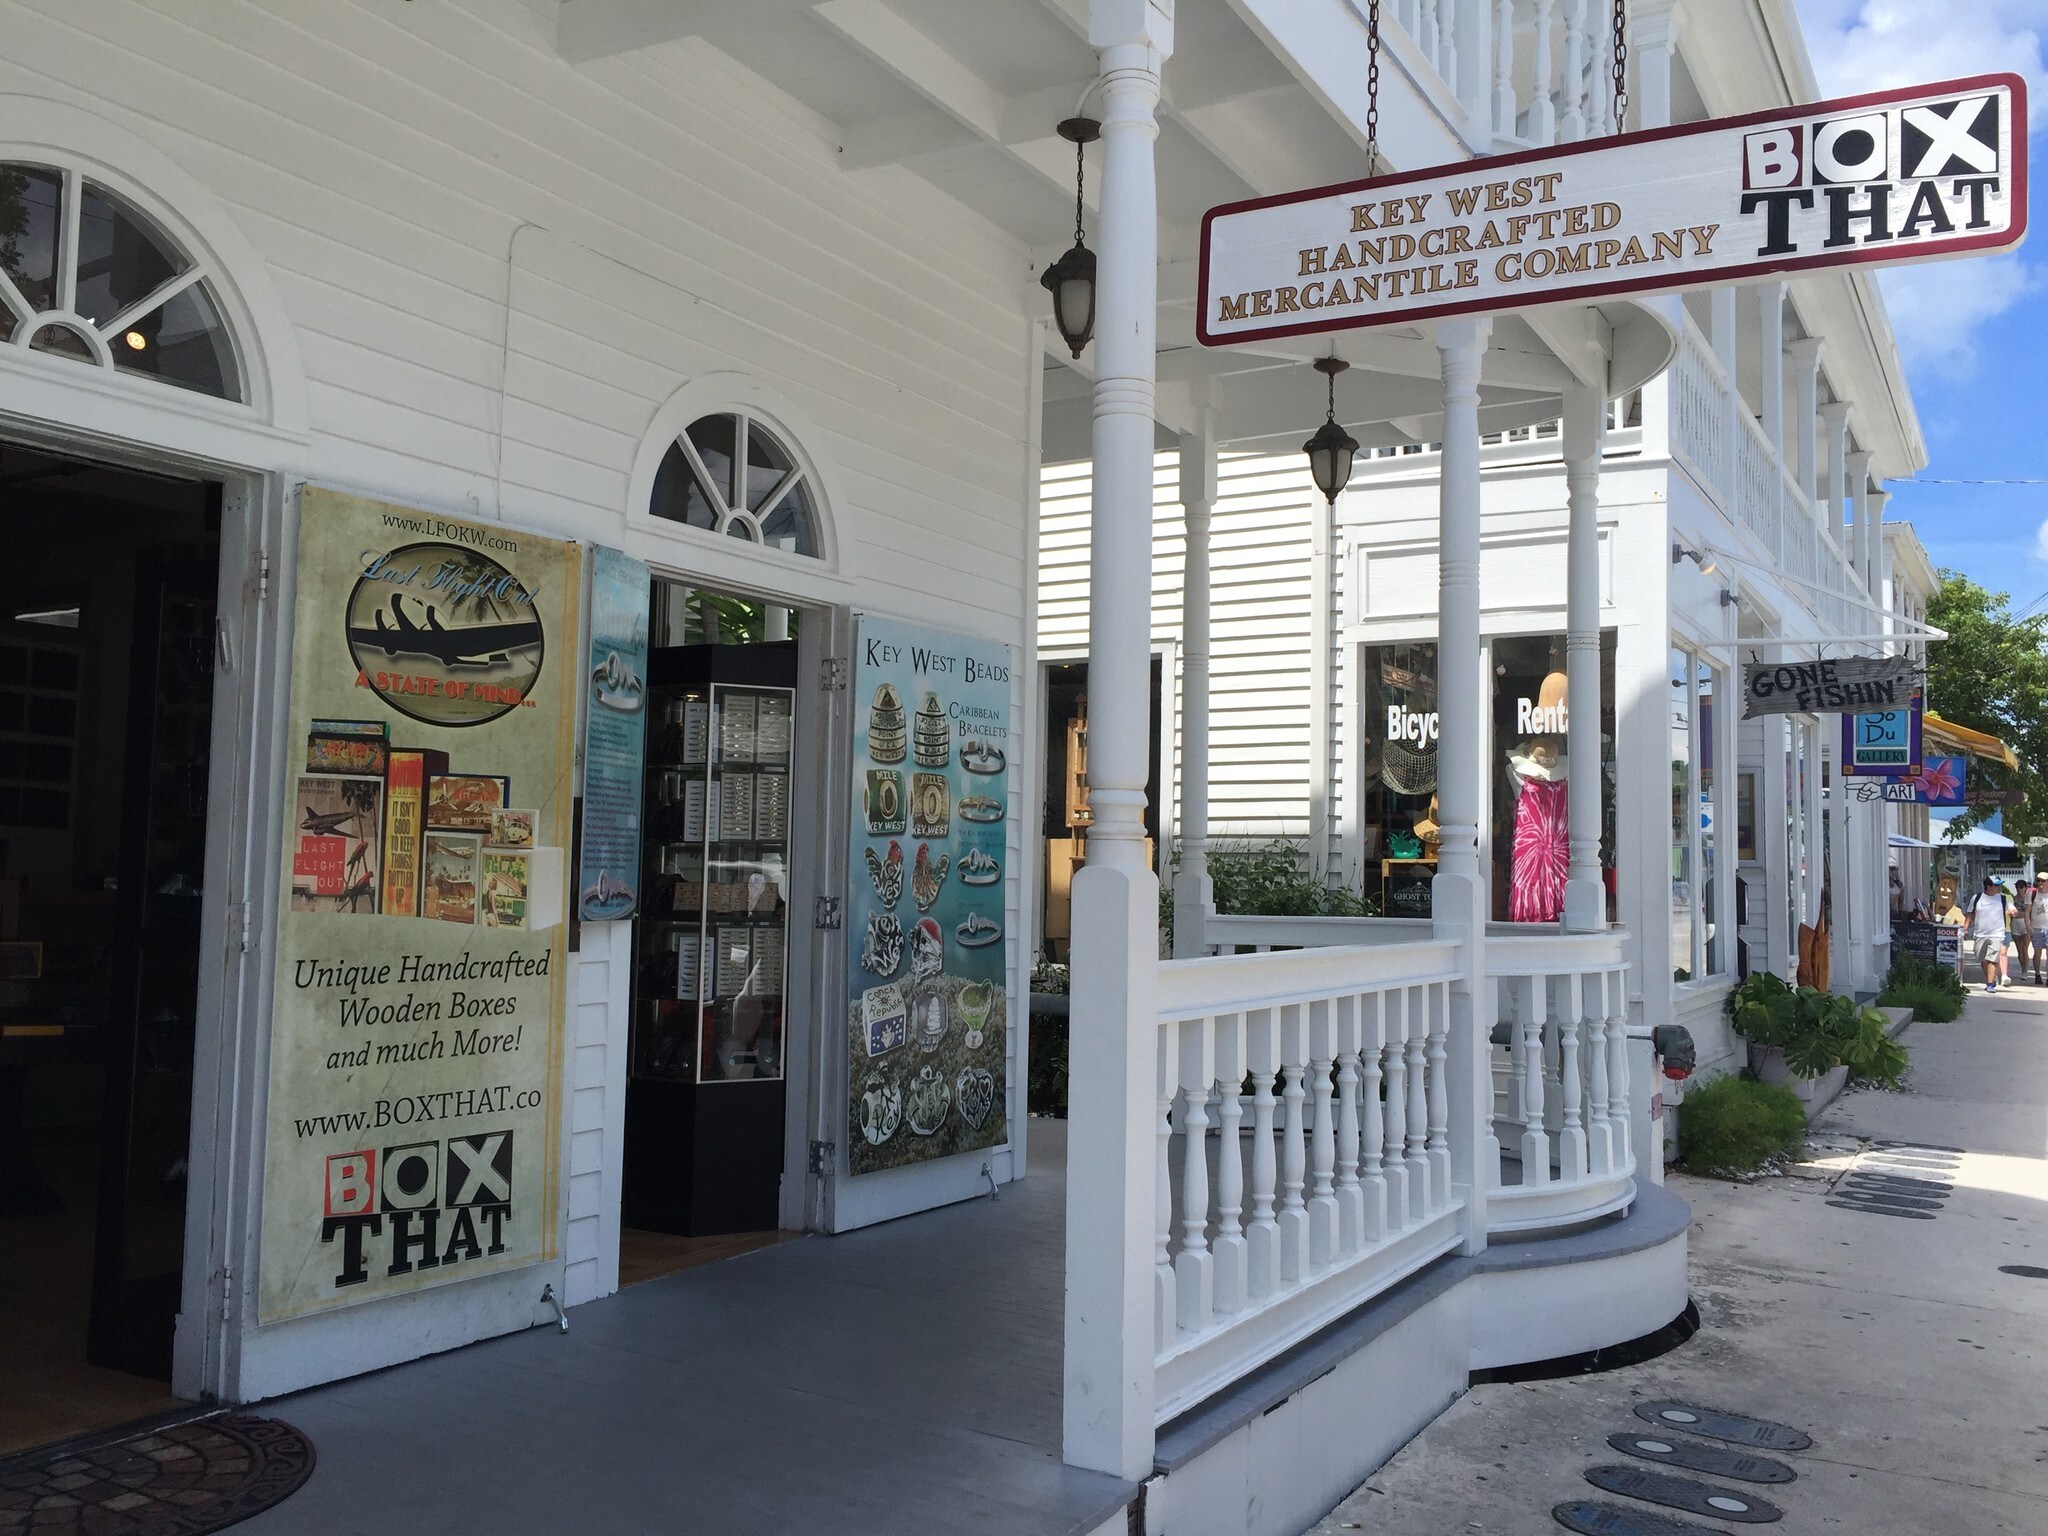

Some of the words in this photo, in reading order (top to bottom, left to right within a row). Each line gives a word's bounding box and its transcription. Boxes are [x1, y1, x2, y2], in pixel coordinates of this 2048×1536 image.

[1743, 94, 1999, 190] BOX
[1350, 195, 1431, 232] KEY
[1446, 173, 1562, 217] WEST
[1740, 177, 2000, 256] THAT
[1298, 202, 1622, 276] HANDCRAFTED
[1219, 259, 1479, 321] MERCANTILE
[1494, 225, 1720, 283] COMPANY
[382, 514, 517, 552] www.LFOKW.com
[358, 548, 421, 586] Last
[421, 561, 494, 604] Flight
[494, 574, 540, 606] Out
[354, 668, 371, 689] A
[376, 672, 440, 697] STATE
[444, 680, 469, 699] OF
[1752, 660, 1838, 698] GONE
[1796, 676, 1903, 711] FISHIN'
[1517, 698, 1568, 734] Rent
[1866, 724, 1895, 743] Du
[1857, 750, 1907, 762] GALLERY
[876, 770, 898, 781] MILE
[920, 774, 943, 786] MILE
[1888, 784, 1914, 800] ART
[869, 821, 884, 831] KEY
[885, 820, 905, 830] WEST
[912, 826, 927, 835] KEY
[928, 825, 948, 835] WEST
[303, 843, 336, 853] LAST
[391, 835, 399, 851] TO
[400, 836, 415, 853] KEEP
[295, 859, 344, 872] FLIGHT
[318, 877, 345, 888] OUT
[1394, 893, 1421, 901] GHOST
[295, 959, 390, 994] Unique
[397, 949, 551, 983] Handcrafted
[339, 993, 441, 1027] Wooden
[448, 992, 516, 1018] Boxes
[326, 1041, 372, 1069] and
[376, 1031, 444, 1064] much
[451, 1025, 522, 1057] More!
[294, 1086, 541, 1138] www.BOXTHAT.co
[325, 1131, 512, 1215] BOX
[321, 1204, 512, 1288] THAT
